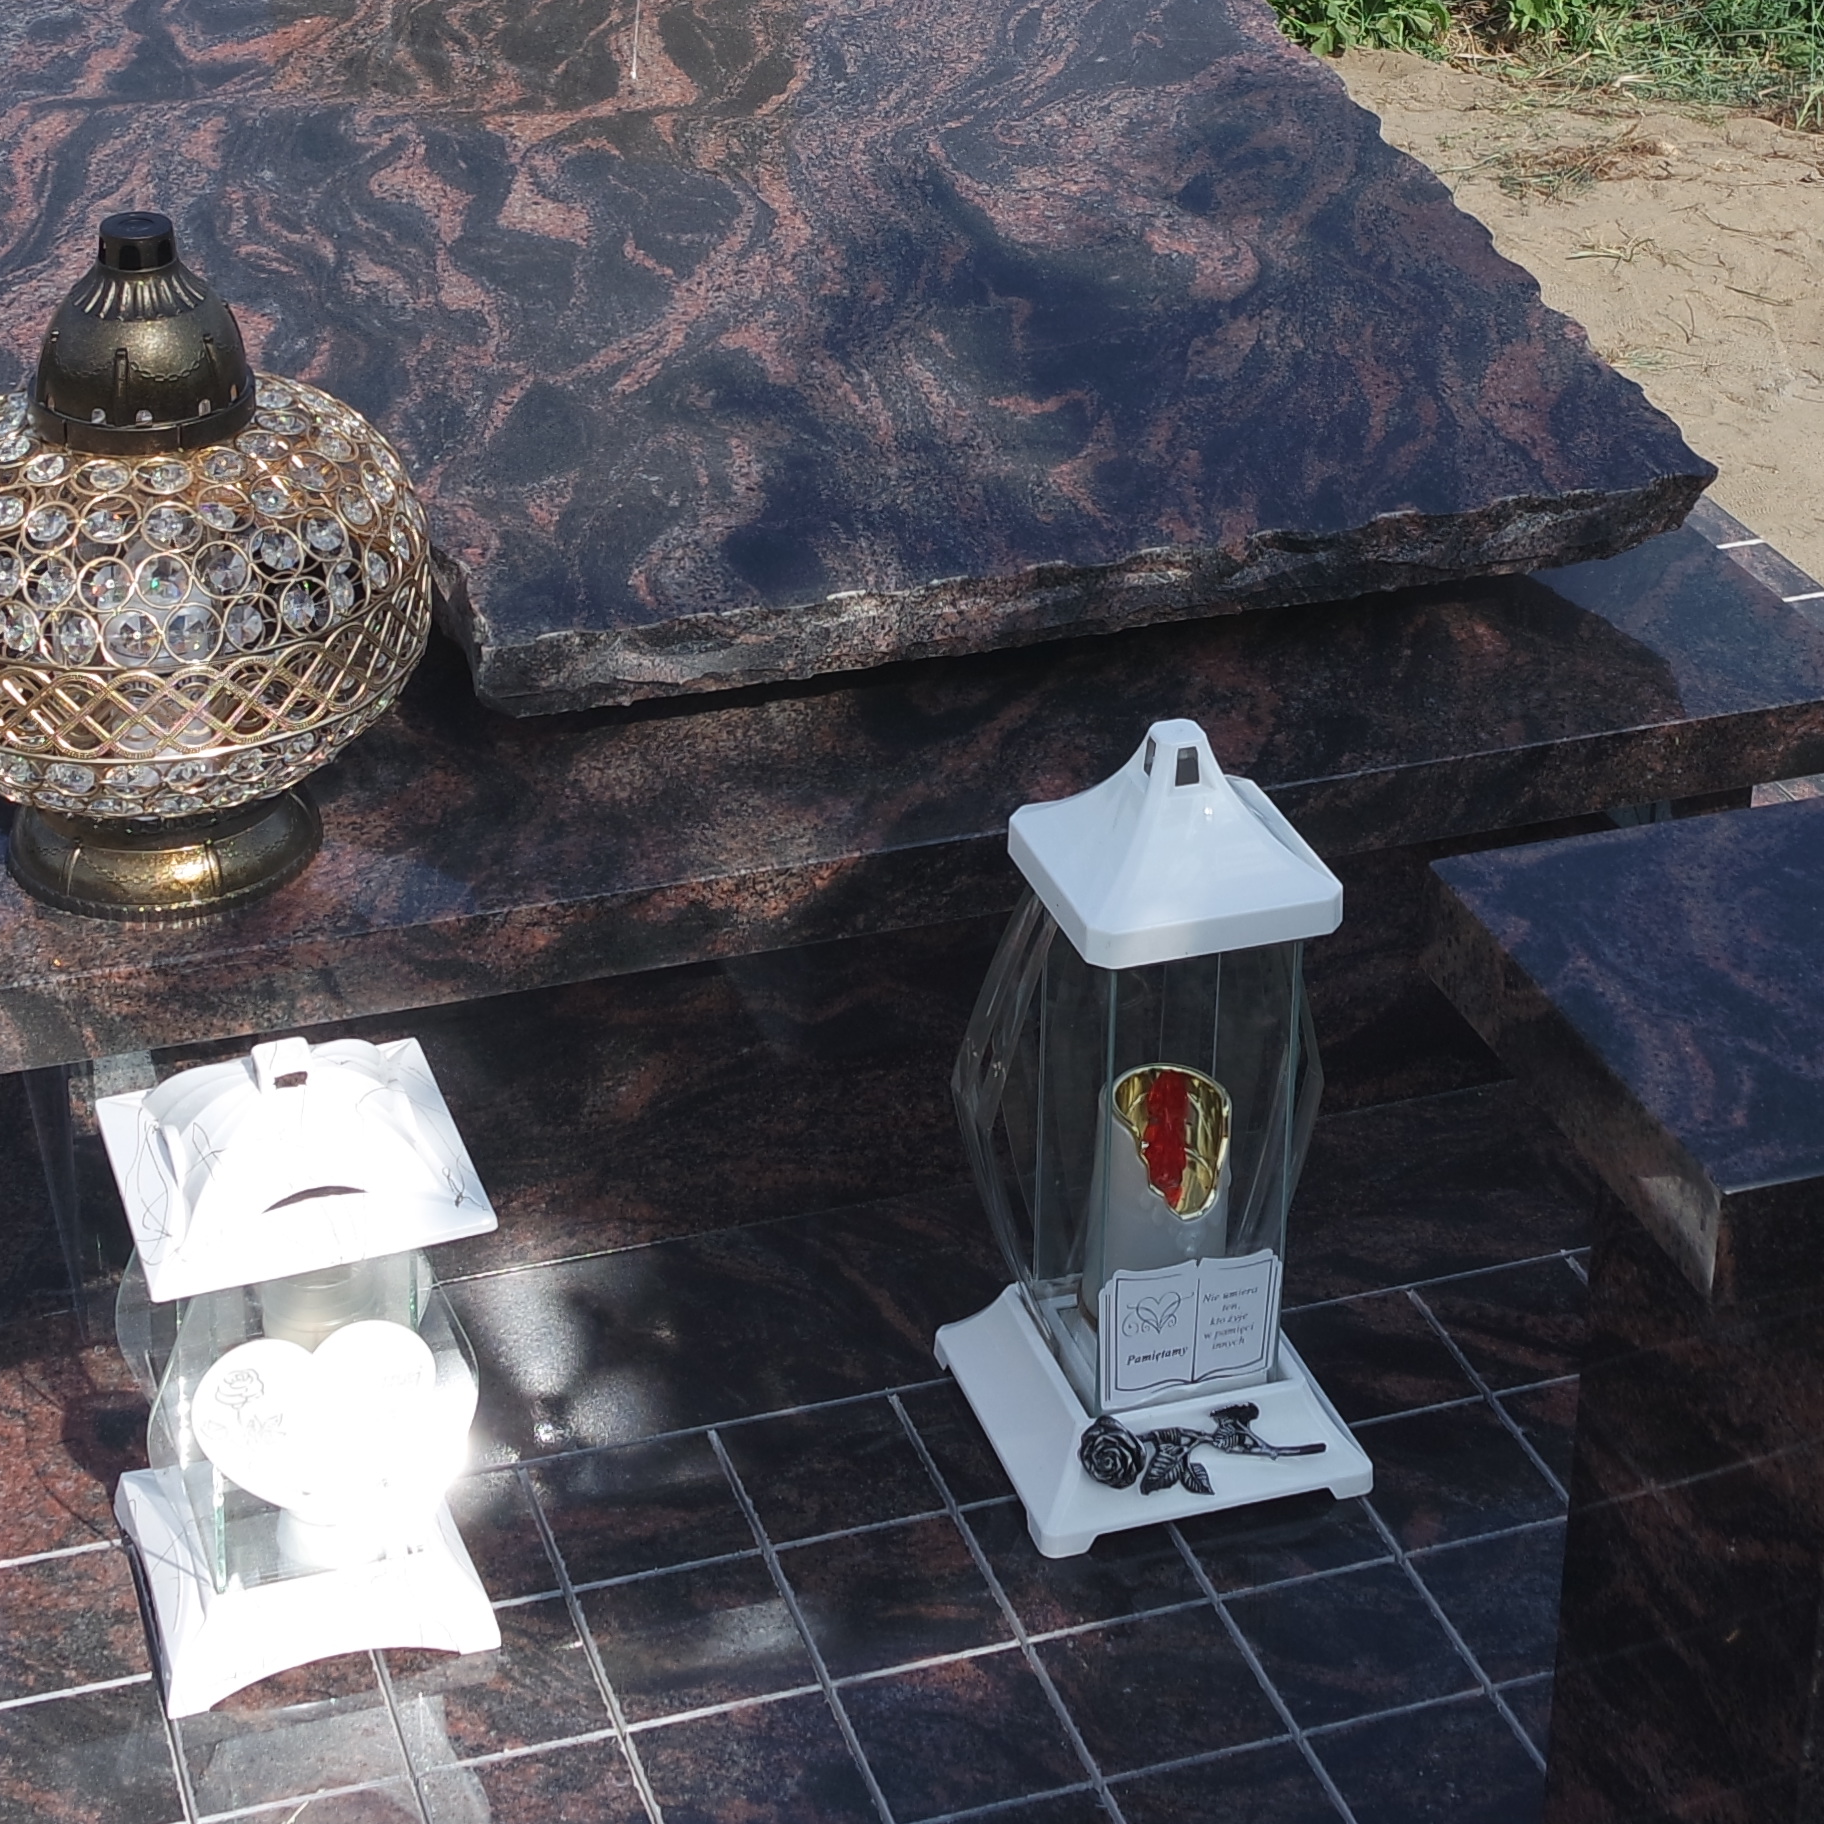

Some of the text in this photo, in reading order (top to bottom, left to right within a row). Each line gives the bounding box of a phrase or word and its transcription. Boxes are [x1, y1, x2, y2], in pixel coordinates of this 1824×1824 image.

[1203, 1286, 1259, 1304] Nie umiera
[1213, 1323, 1255, 1342] pamięci
[1211, 1337, 1246, 1352] innych
[1126, 1345, 1189, 1367] Pamiętamy
